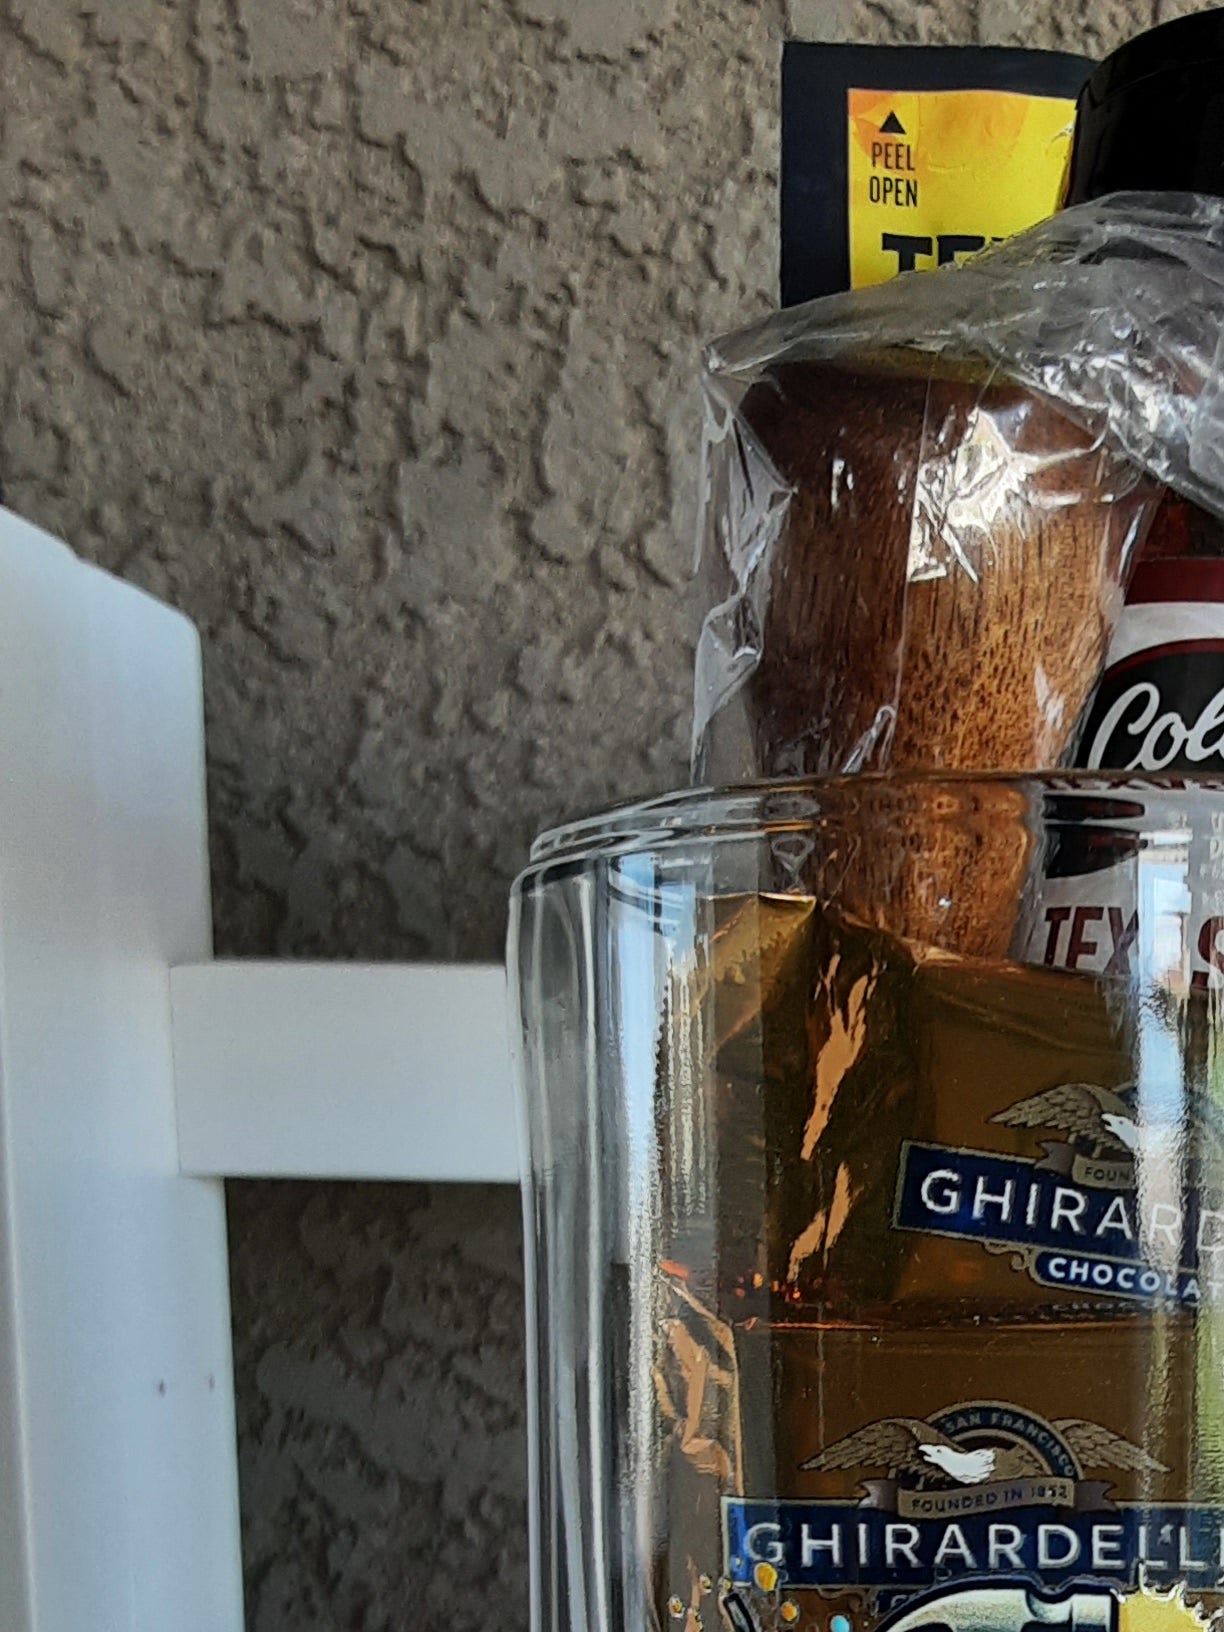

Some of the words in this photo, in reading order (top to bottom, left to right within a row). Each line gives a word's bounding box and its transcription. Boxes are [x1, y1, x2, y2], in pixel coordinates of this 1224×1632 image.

[871, 142, 916, 172] PEEL
[867, 176, 918, 208] OPEN
[945, 1411, 982, 1434] SAN
[991, 1411, 1076, 1476] FRANCISCO
[911, 1492, 998, 1513] FOUNDED
[1003, 1486, 1023, 1502] IN
